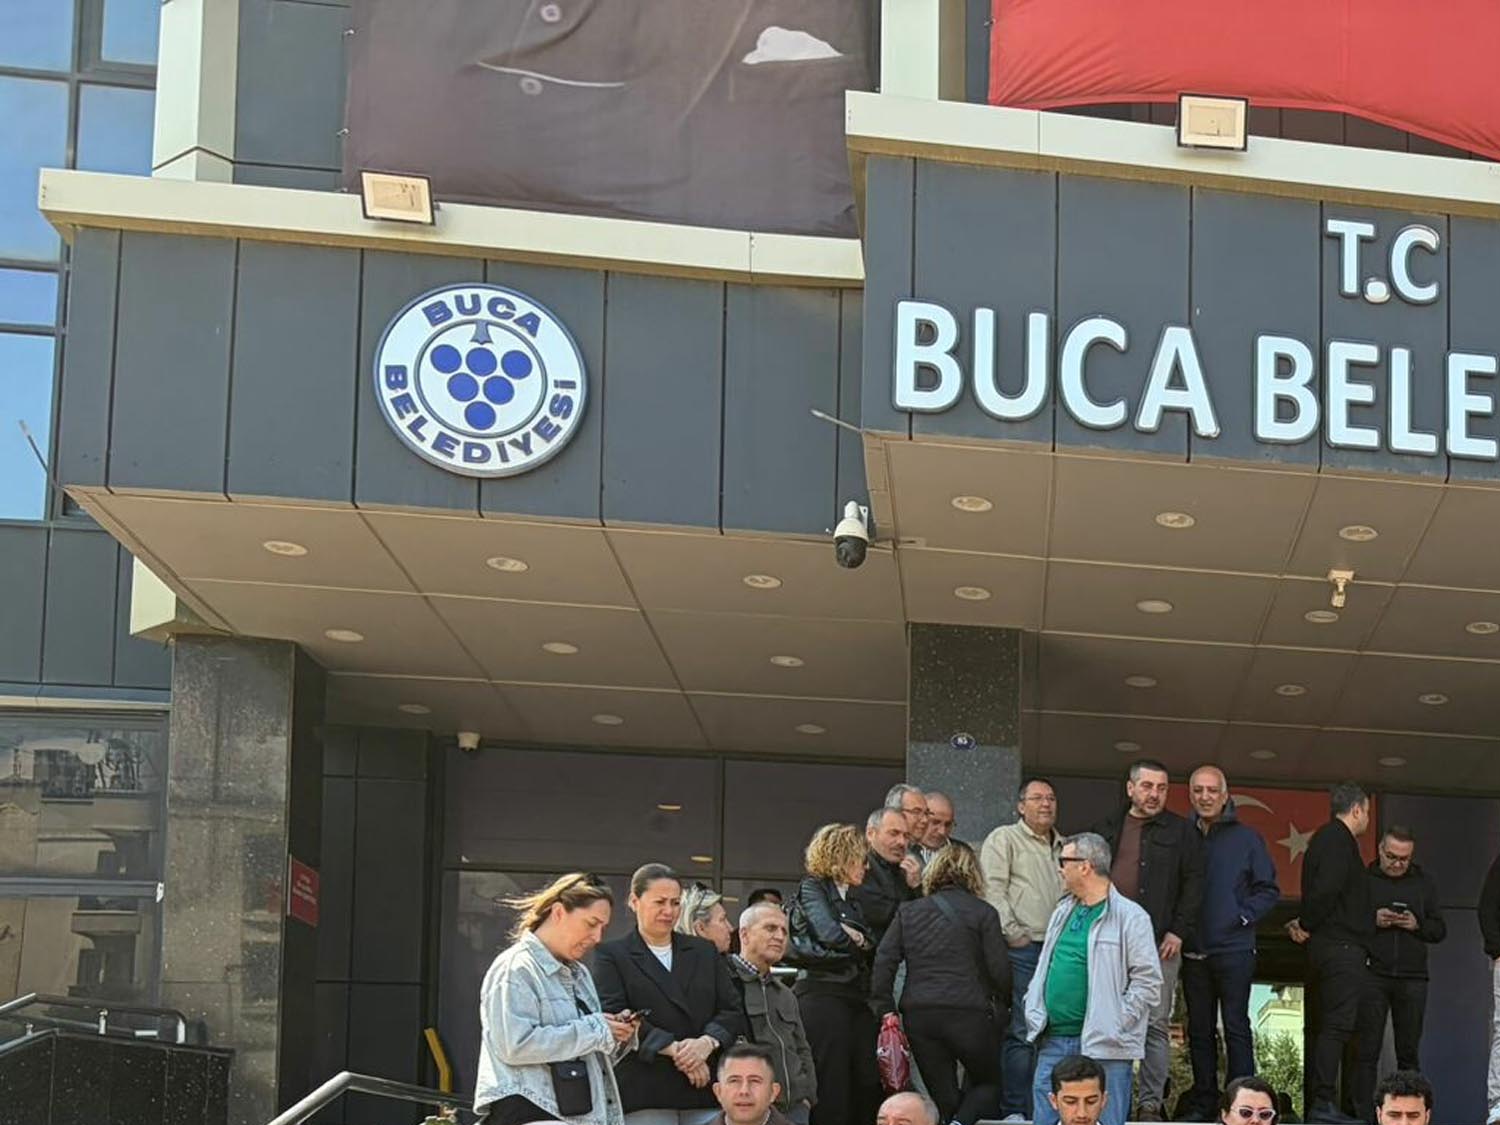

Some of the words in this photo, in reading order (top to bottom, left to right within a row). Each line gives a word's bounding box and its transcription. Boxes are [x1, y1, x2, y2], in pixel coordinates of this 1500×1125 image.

[1326, 217, 1441, 304] T.C
[421, 293, 542, 338] BUCA
[894, 299, 1222, 438] BUCA
